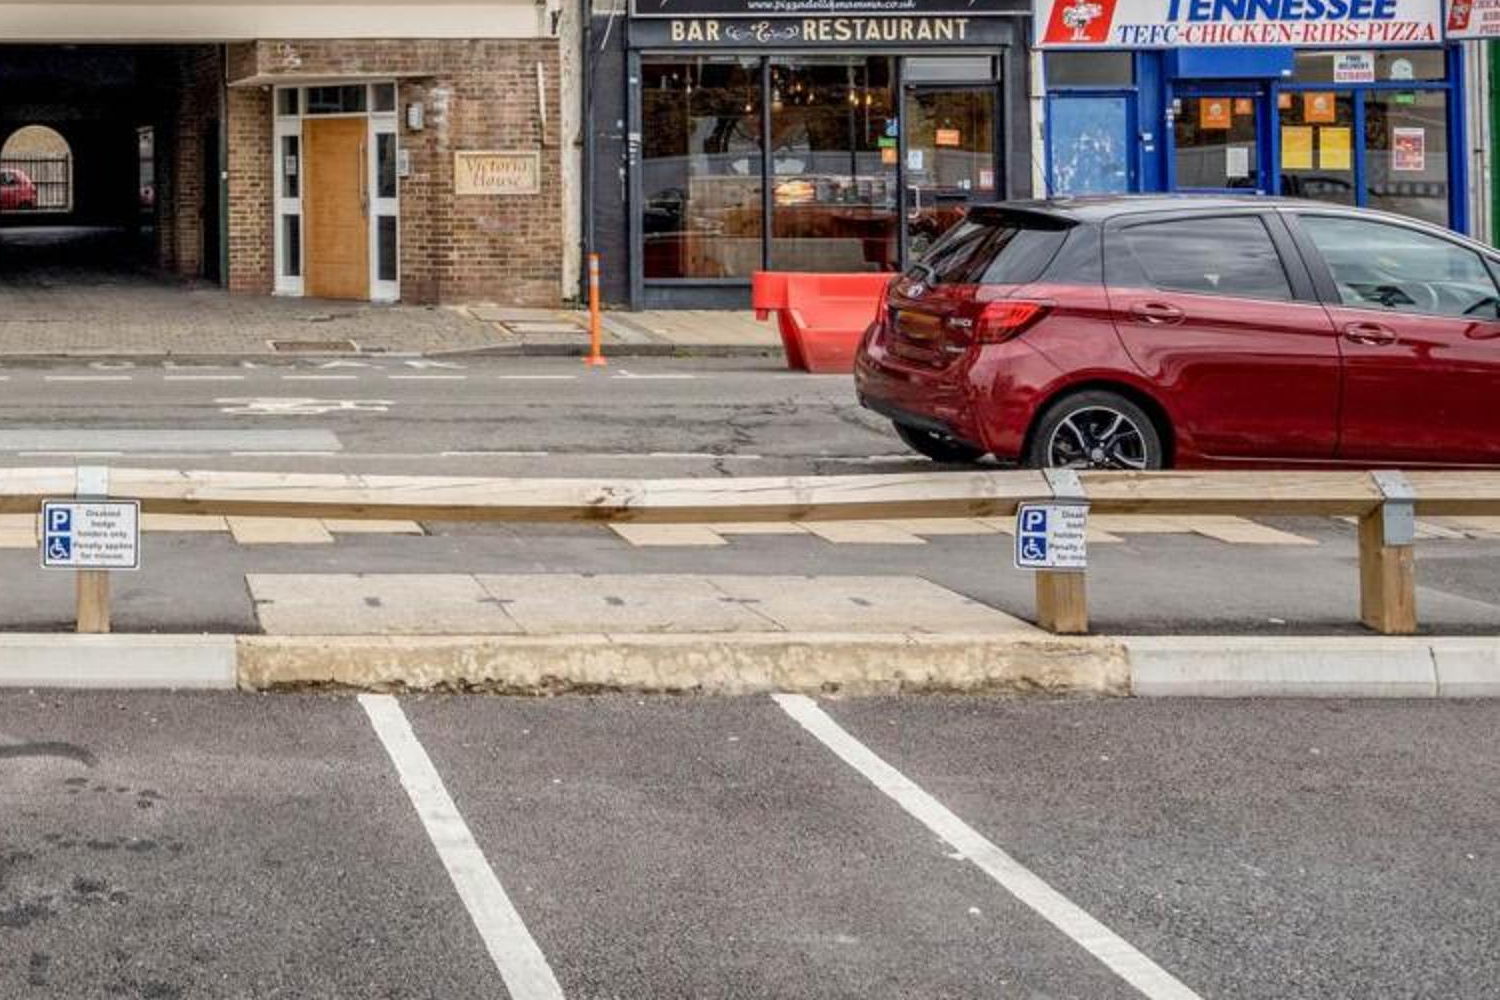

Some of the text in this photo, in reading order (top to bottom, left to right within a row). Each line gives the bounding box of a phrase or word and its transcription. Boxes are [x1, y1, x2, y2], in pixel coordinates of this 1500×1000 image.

[671, 20, 720, 41] BAR
[803, 18, 970, 41] RESTAURANT
[51, 510, 69, 531] P
[1027, 511, 1044, 532] P
